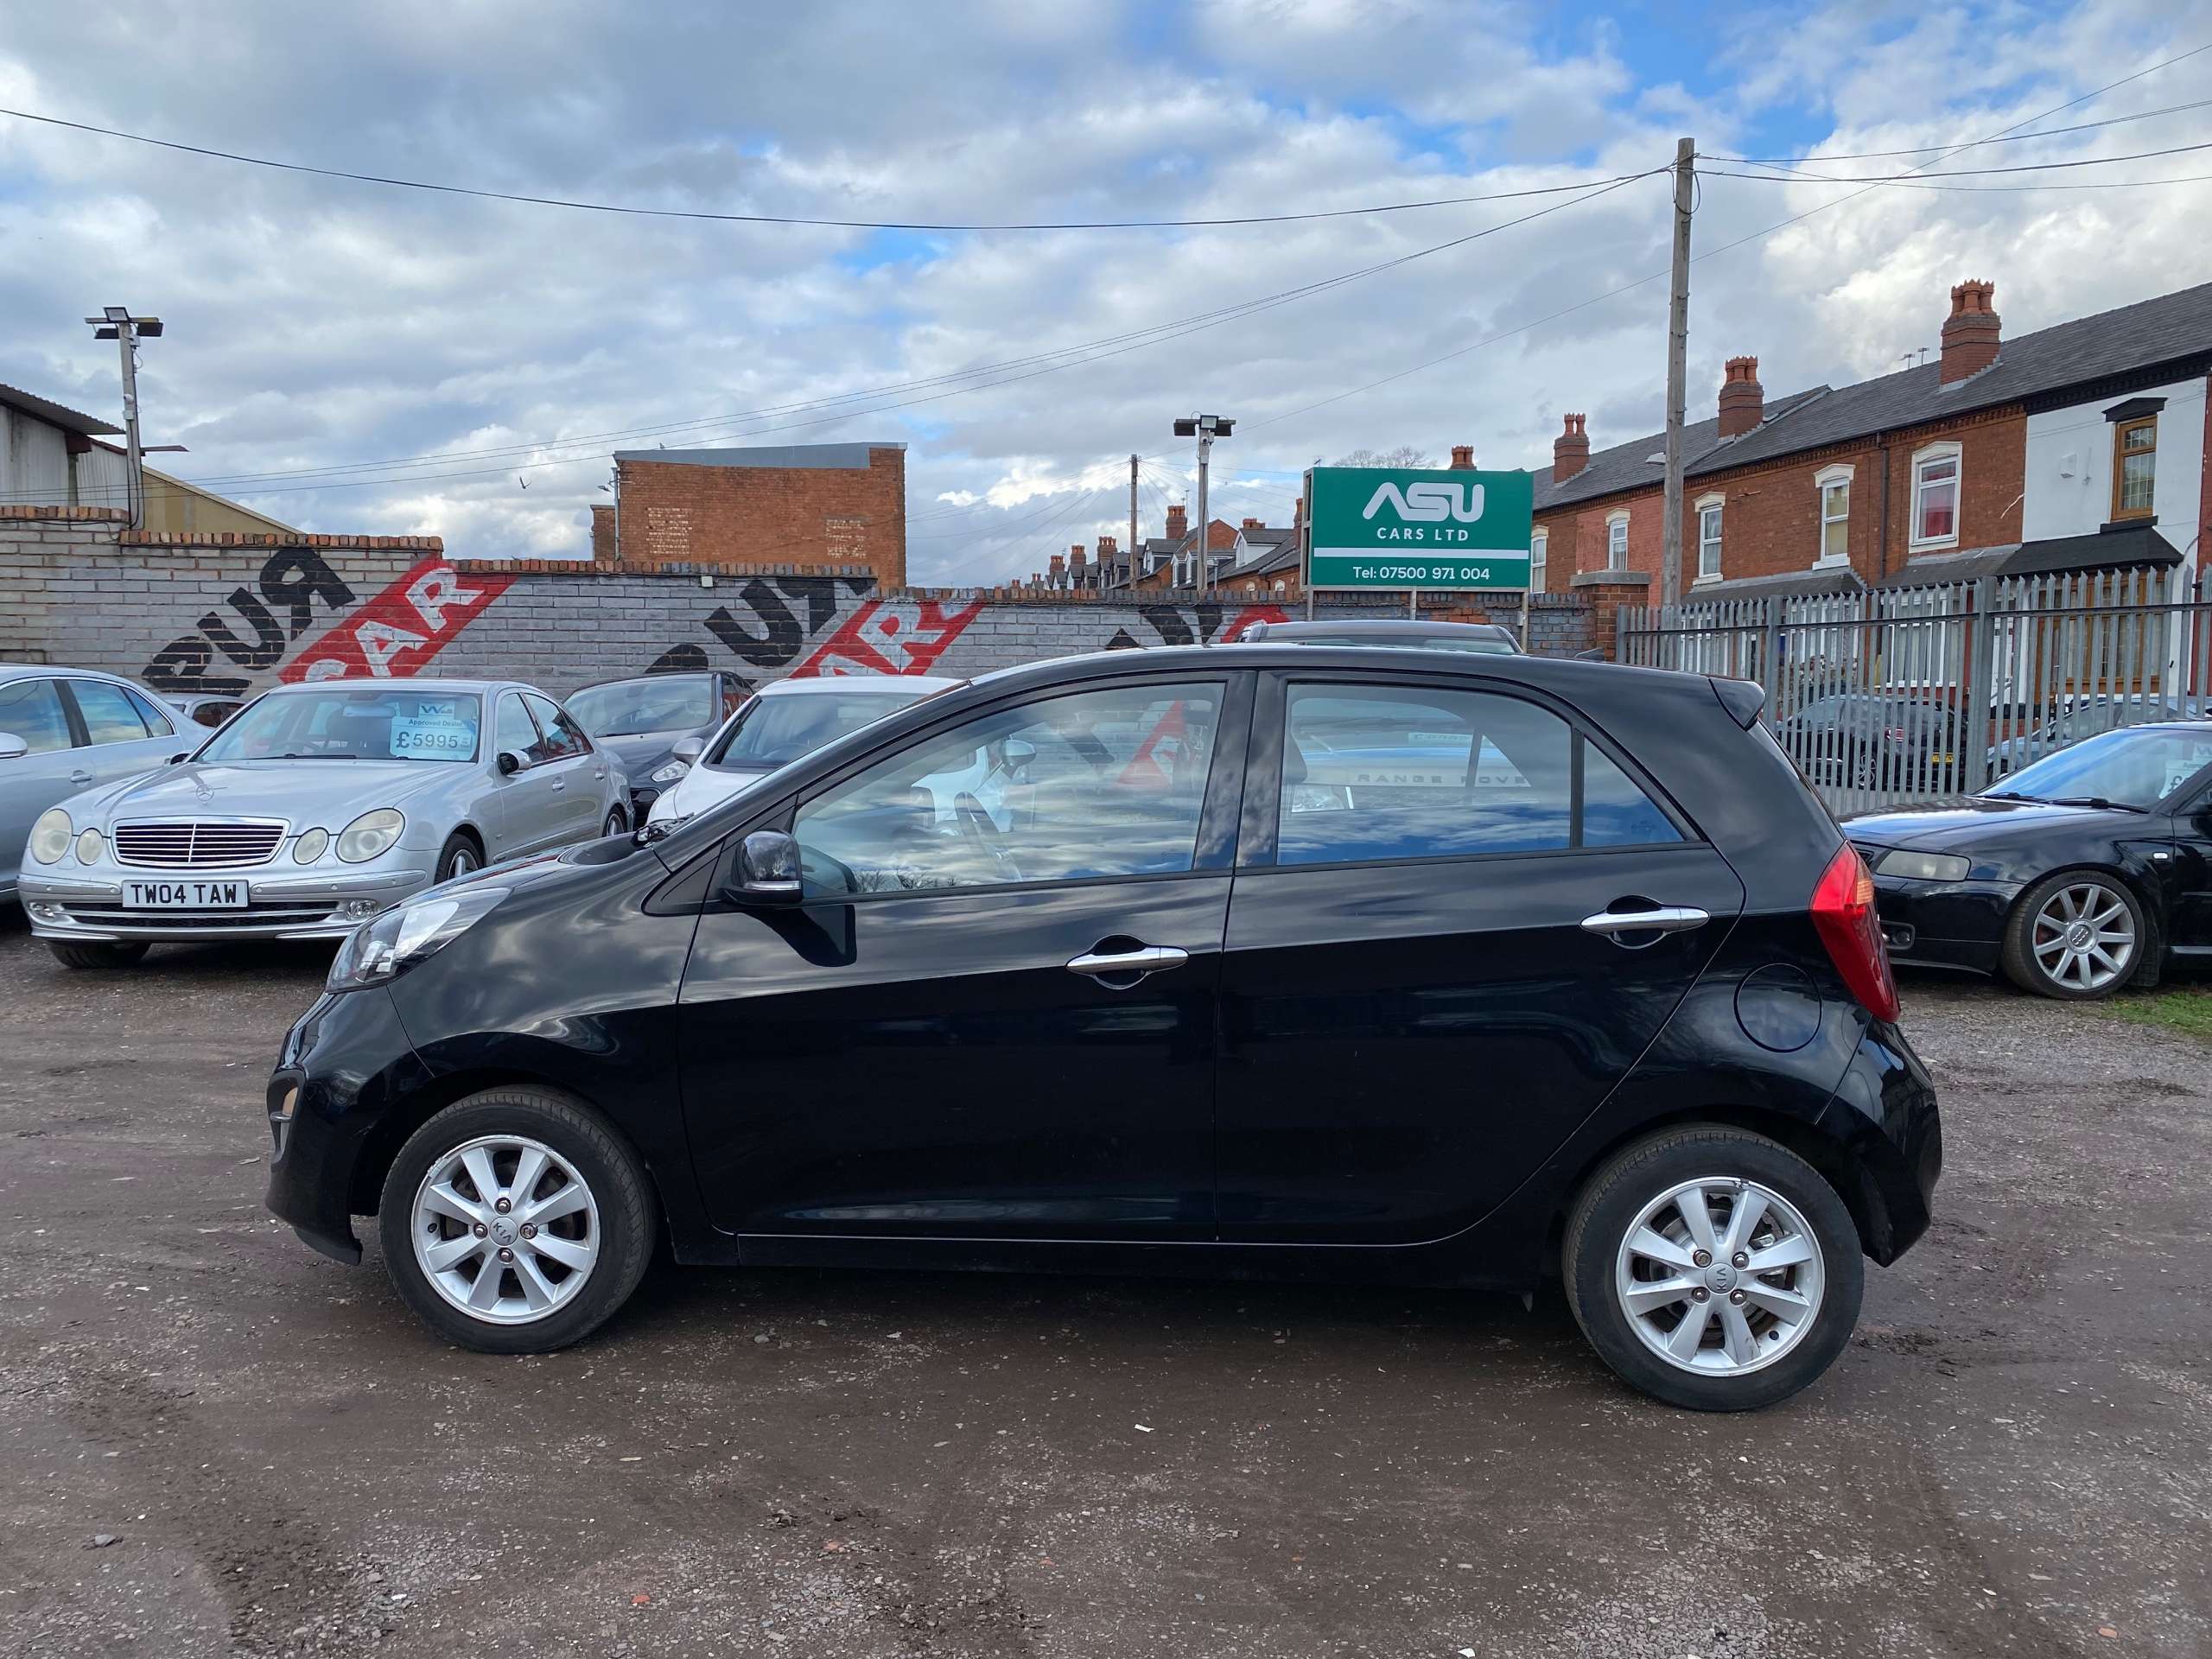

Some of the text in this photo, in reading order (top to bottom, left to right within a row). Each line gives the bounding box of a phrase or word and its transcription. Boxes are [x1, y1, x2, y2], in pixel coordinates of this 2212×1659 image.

[1363, 482, 1484, 523] ASU
[1376, 527, 1469, 541] CARS LTD
[1352, 567, 1491, 580] Tel: 07500 971 004
[396, 731, 458, 748] £5995
[1357, 774, 1442, 784] RANGE
[130, 884, 237, 904] TW04 TAW
